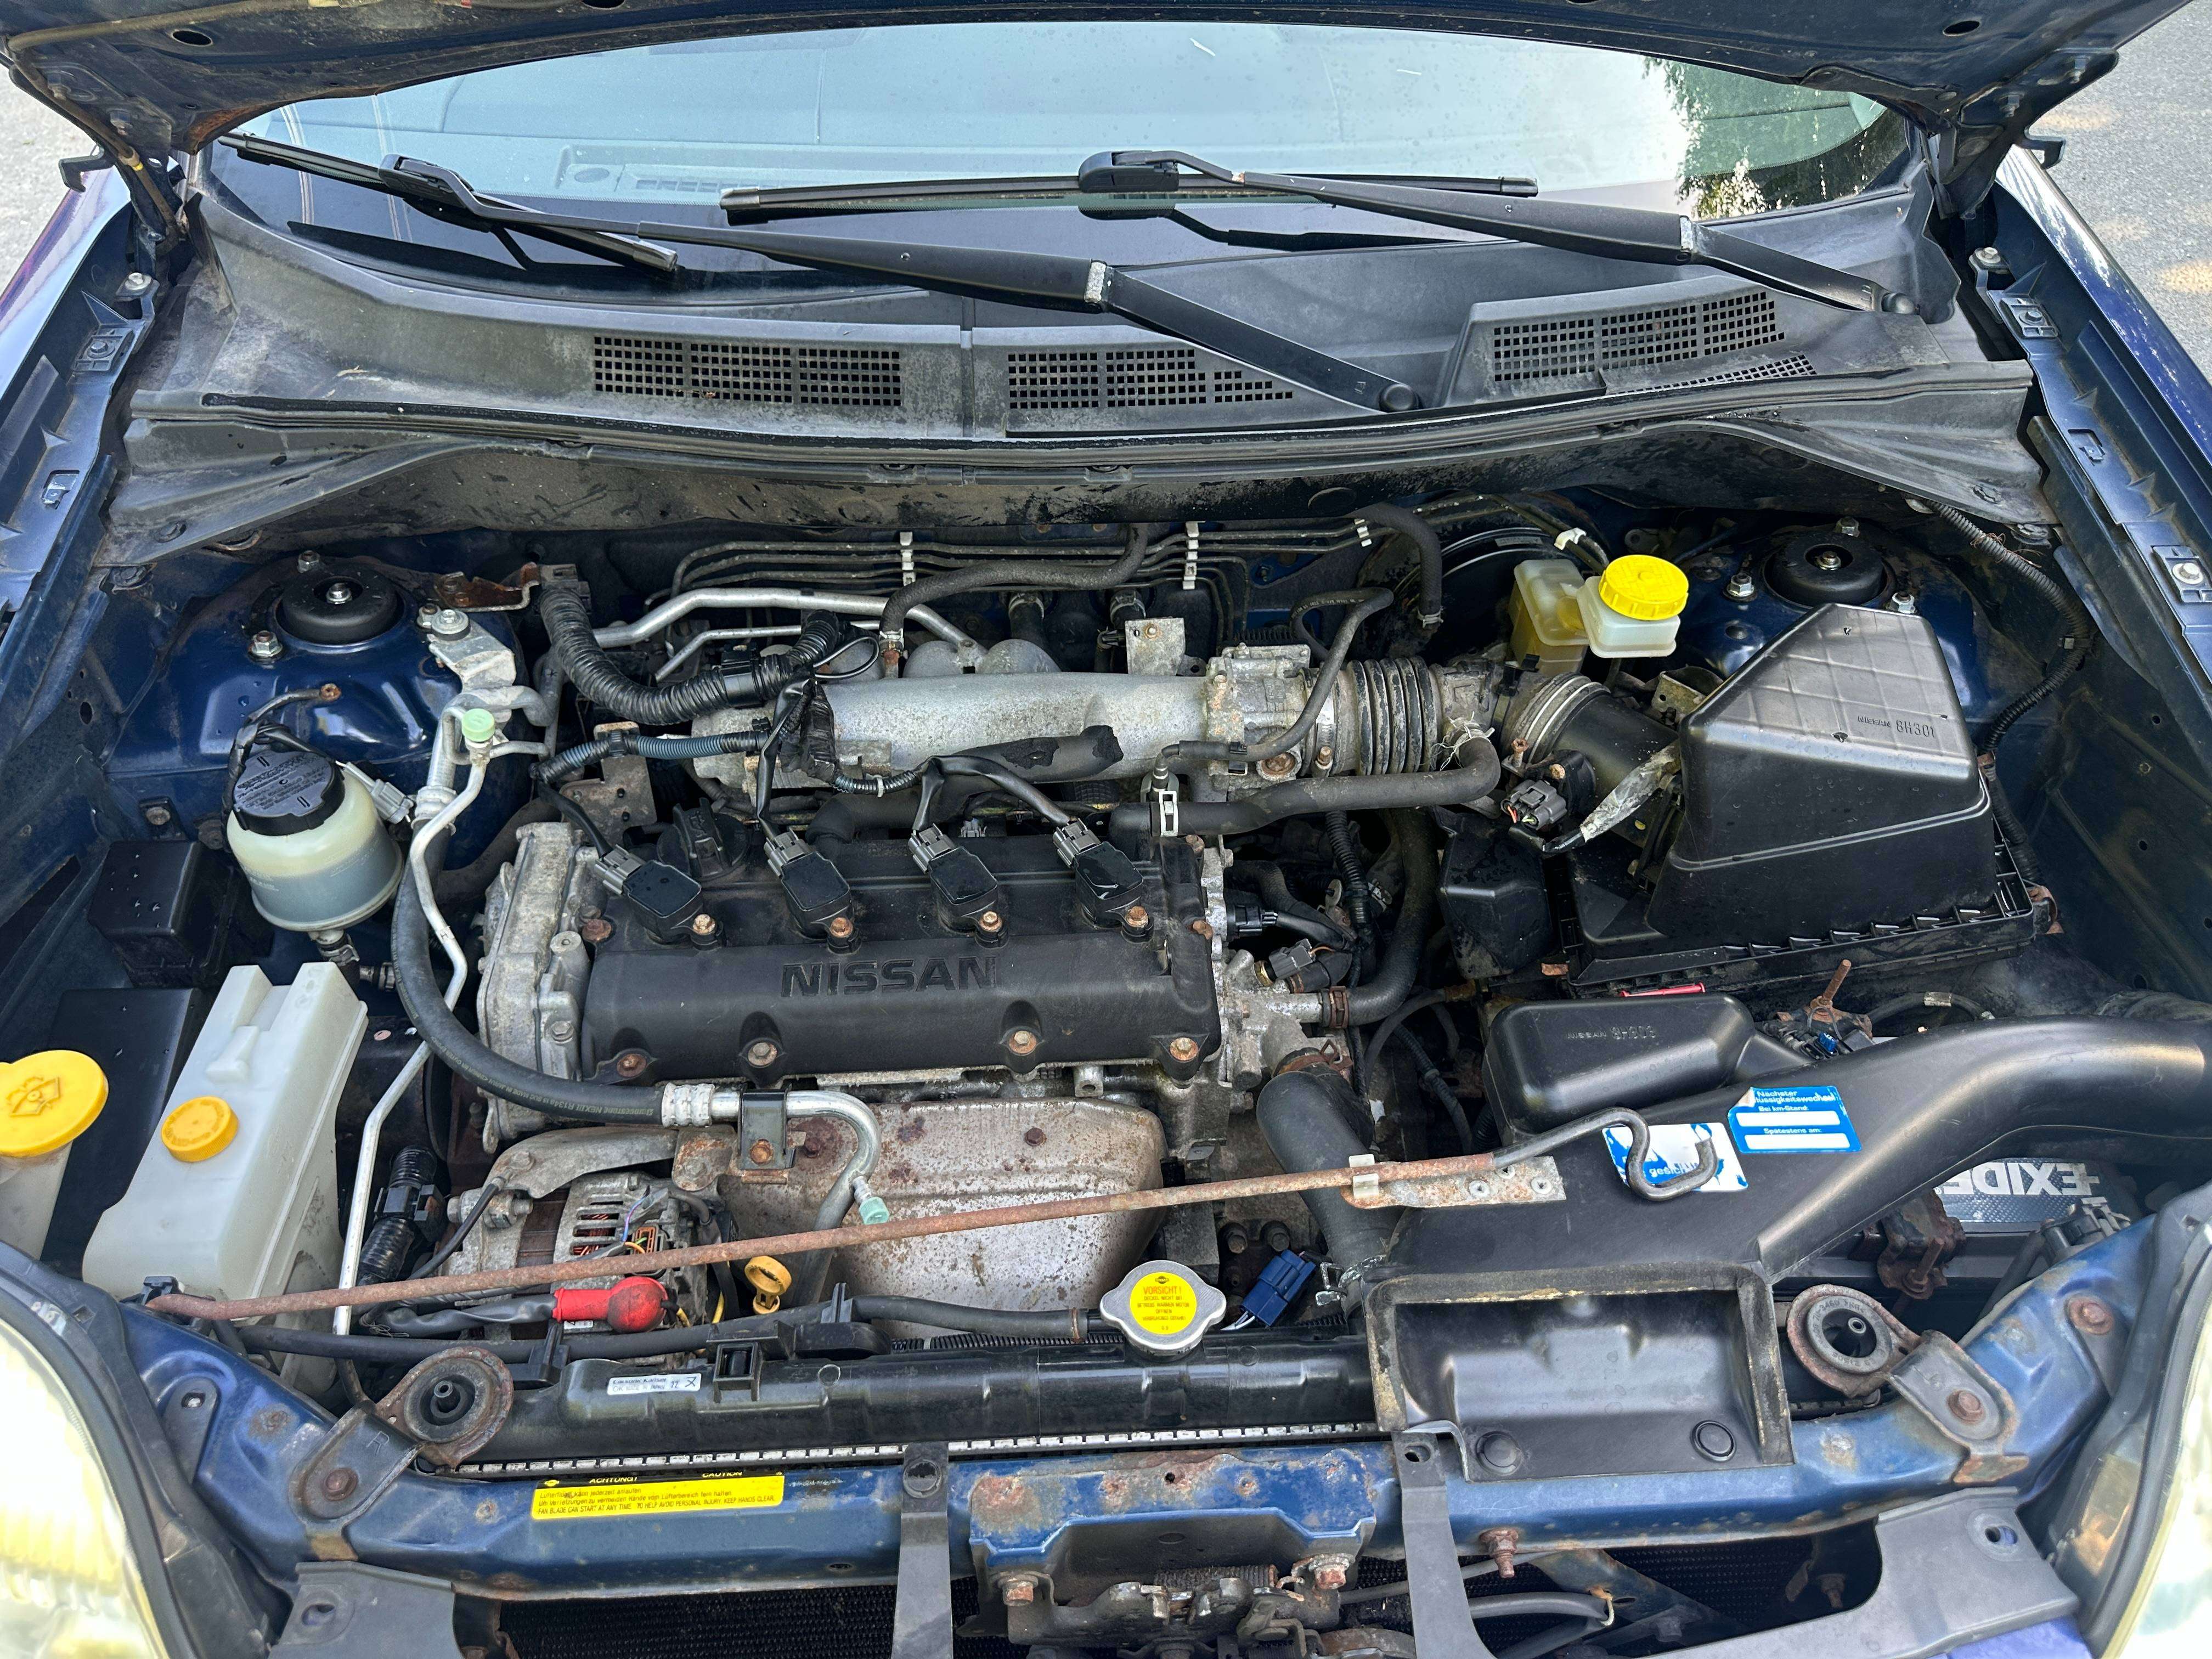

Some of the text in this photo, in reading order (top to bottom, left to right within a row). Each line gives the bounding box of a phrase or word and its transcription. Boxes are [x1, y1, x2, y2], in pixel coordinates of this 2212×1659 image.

[1858, 715, 1935, 738] NISSAN 8H301
[781, 956, 997, 997] NISSAN
[1756, 1093, 1836, 1104] lüssigkeitswechsel
[1943, 1162, 2100, 1195] EXIDE
[1143, 1286, 1177, 1294] VORSICHT
[366, 1430, 390, 1456] R
